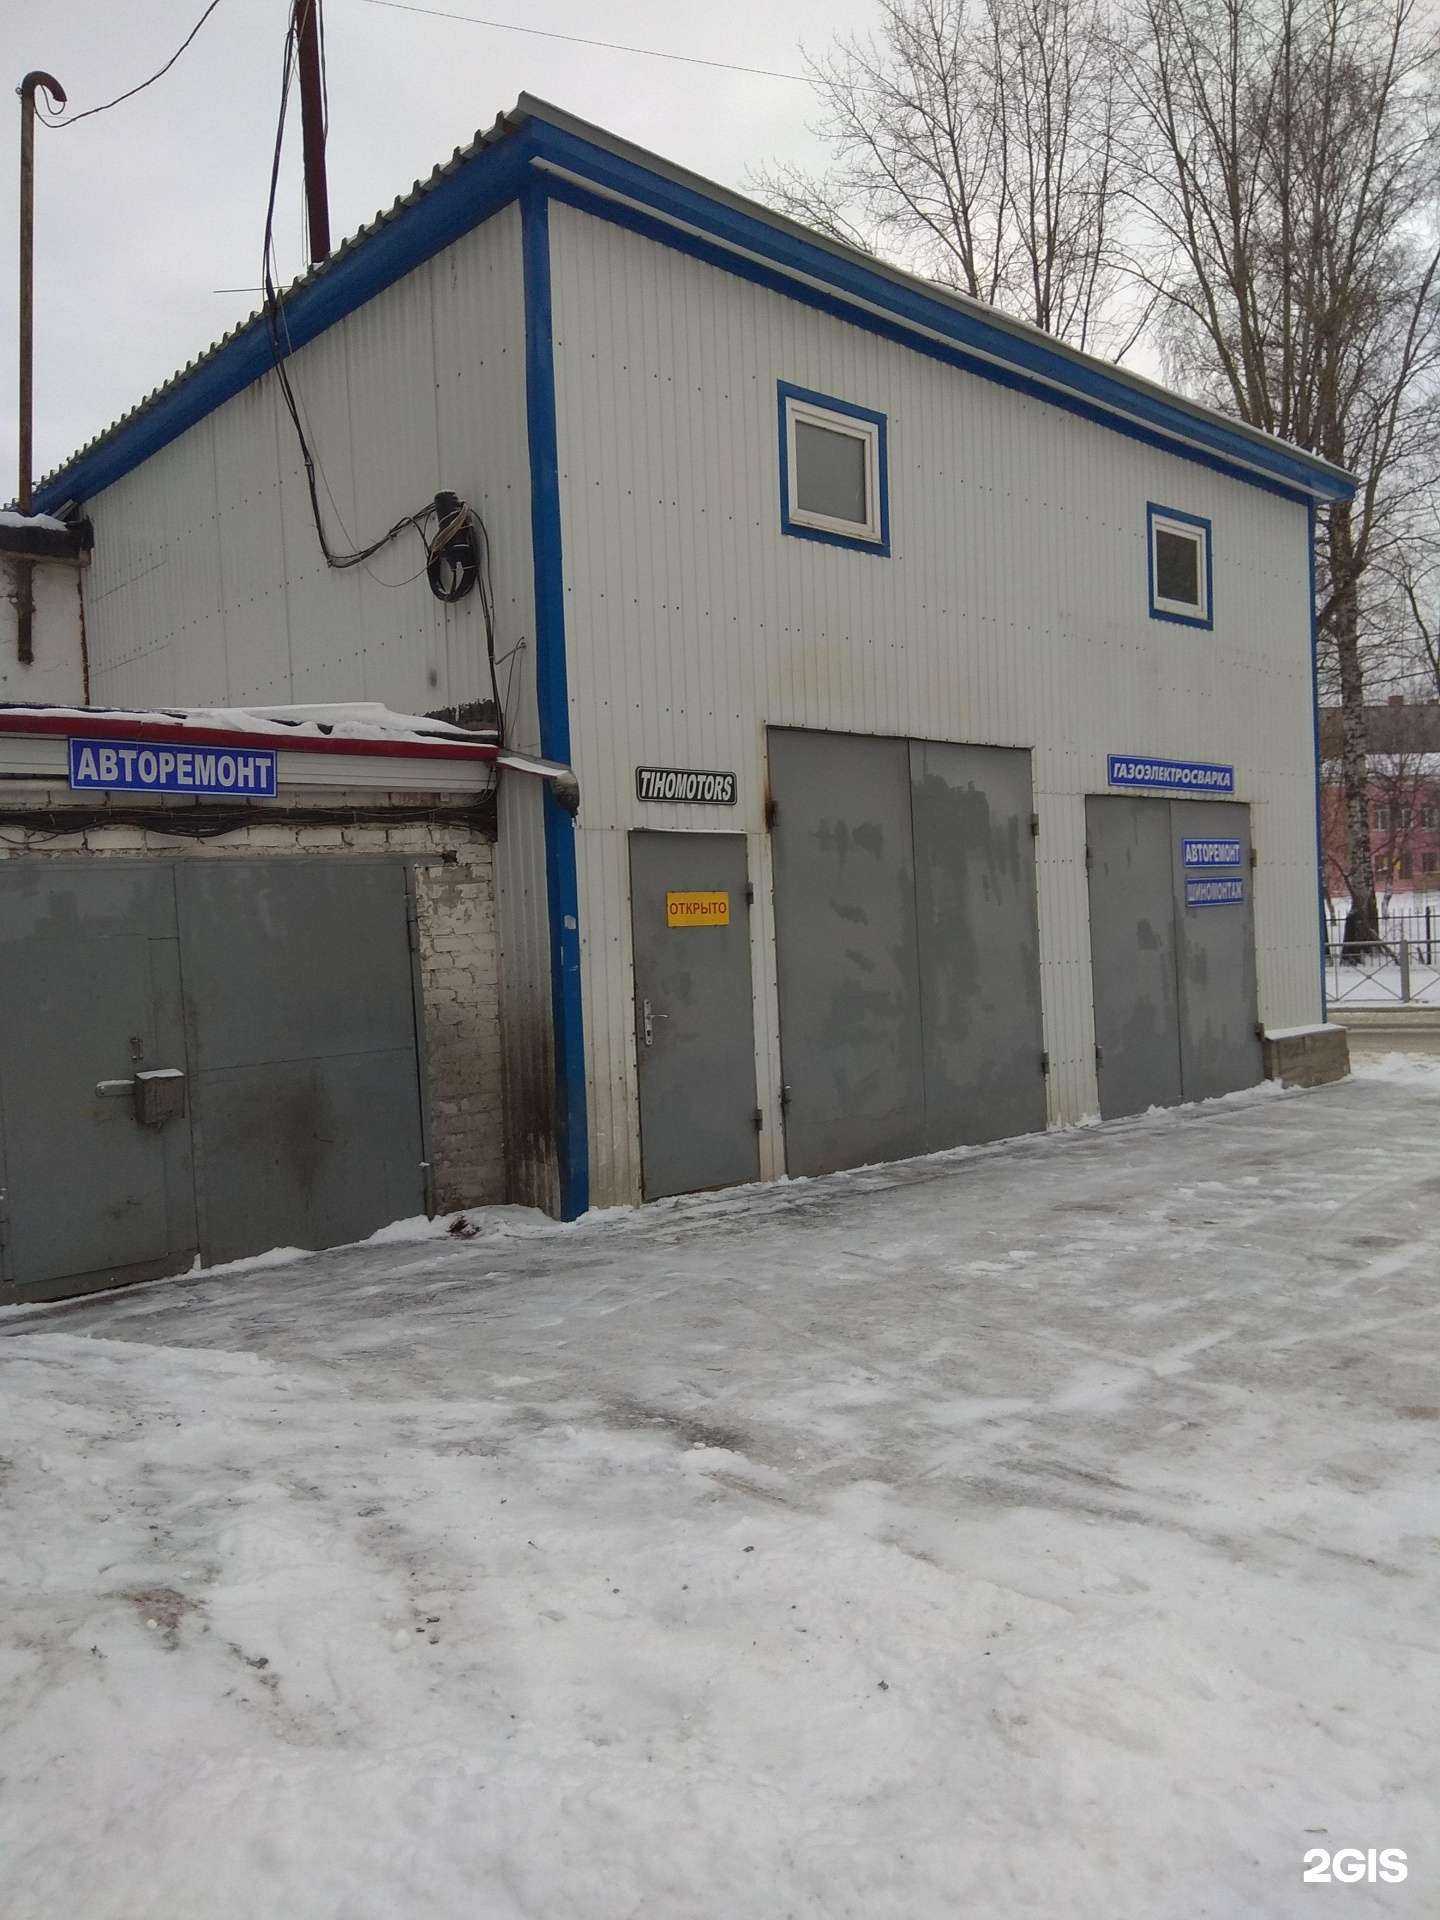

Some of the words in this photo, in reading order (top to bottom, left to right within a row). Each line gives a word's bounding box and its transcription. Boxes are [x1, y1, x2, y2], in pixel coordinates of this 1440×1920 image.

[77, 747, 272, 789] АВТОРЕМОНТ
[1113, 762, 1231, 787] ГАЗОЭЛЕКТРОСВАРКА
[641, 771, 733, 801] TIHOMOTORS
[1185, 844, 1240, 863] АВТОРЕМОНТ
[669, 902, 727, 915] ОТКРЫТО
